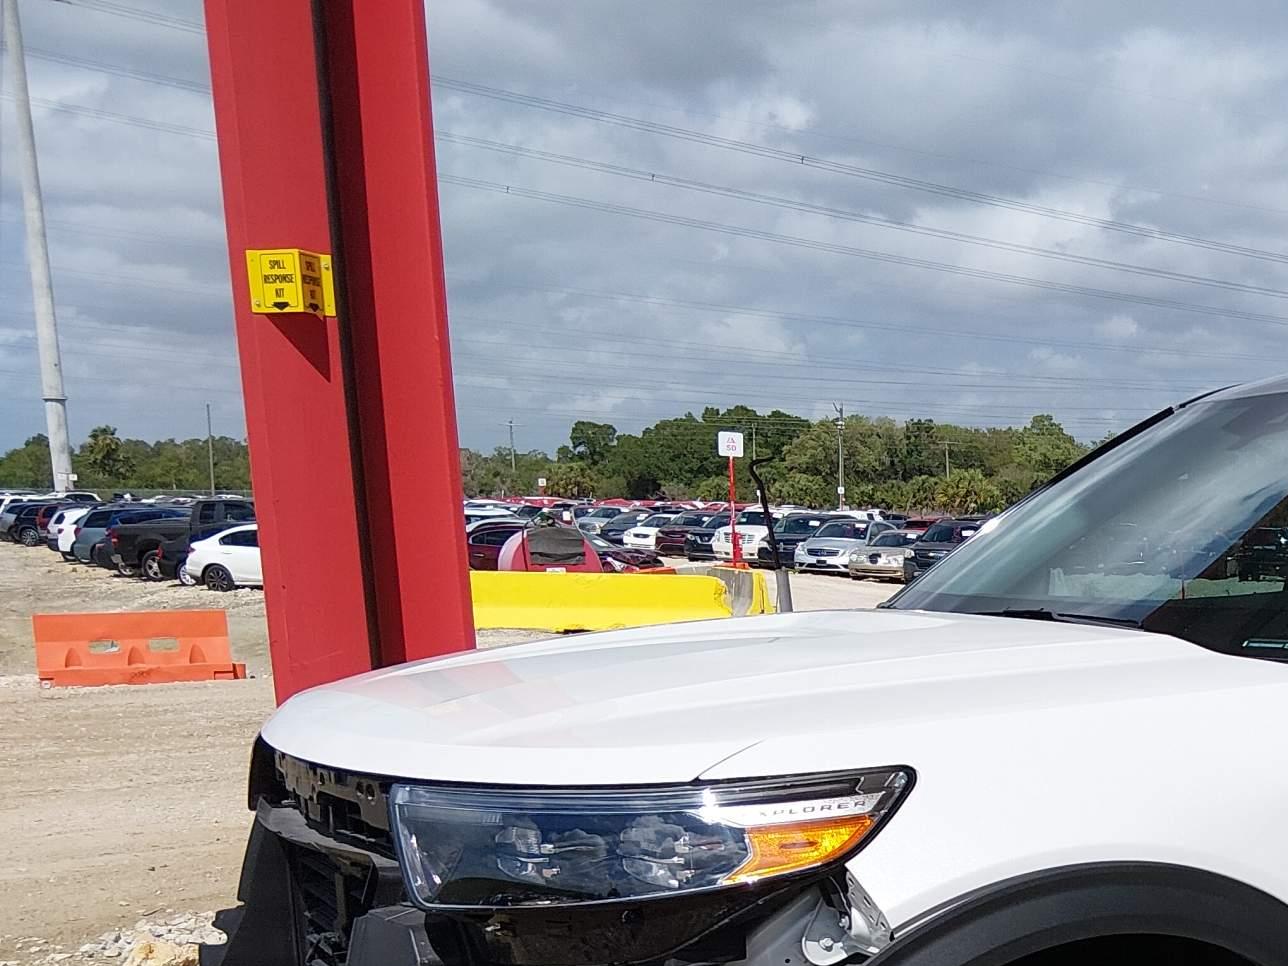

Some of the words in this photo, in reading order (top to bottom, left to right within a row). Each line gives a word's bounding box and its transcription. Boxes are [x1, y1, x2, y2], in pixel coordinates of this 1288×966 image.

[268, 259, 287, 270] SPILL
[263, 273, 295, 284] RESPONSE
[274, 287, 285, 298] KIT
[758, 799, 866, 817] XPLORER
